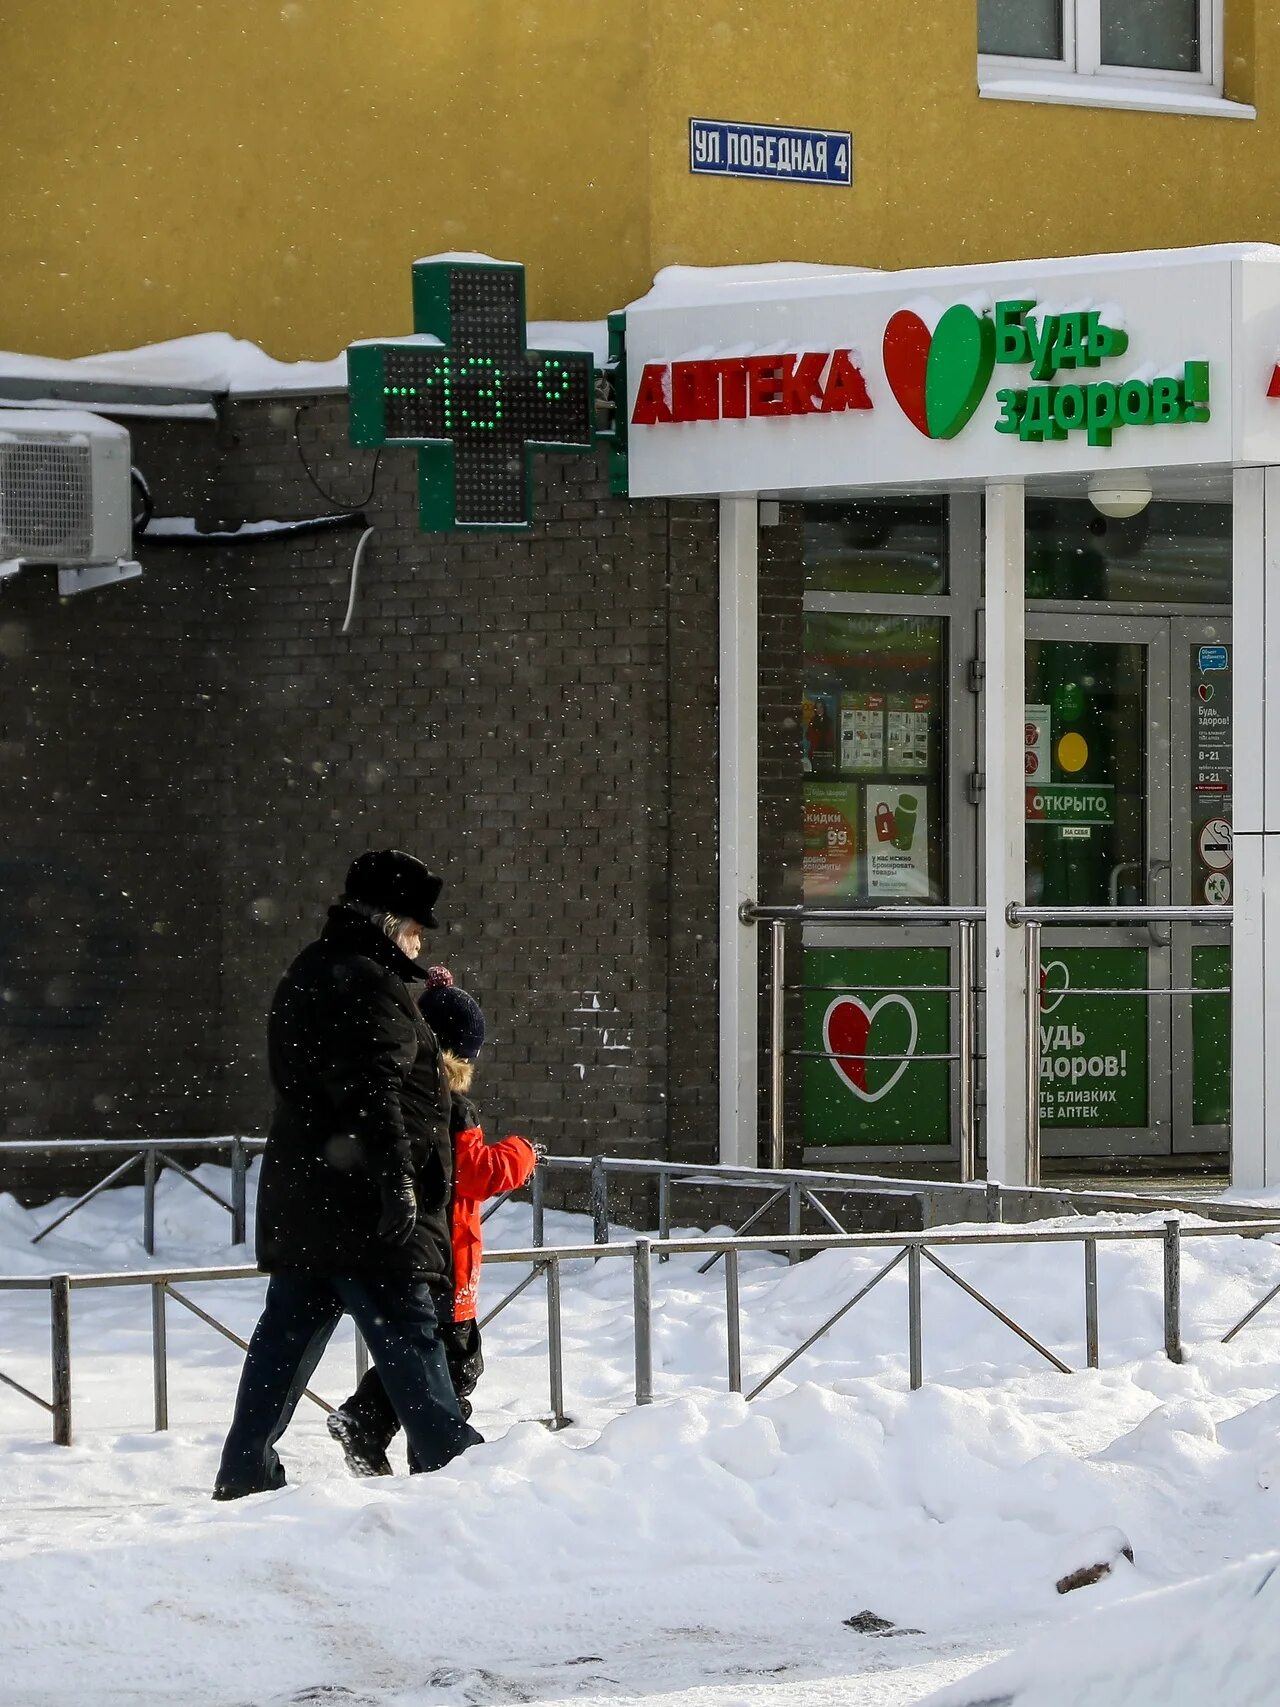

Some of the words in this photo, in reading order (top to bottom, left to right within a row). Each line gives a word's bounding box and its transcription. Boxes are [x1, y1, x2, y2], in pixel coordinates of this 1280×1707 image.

[695, 130, 725, 163] УЛ.
[727, 132, 827, 173] ПОБЕДНАЯ
[834, 143, 847, 174] 4
[995, 300, 1129, 381] Будь
[631, 349, 874, 424] АПТЕКА
[994, 361, 1210, 446] здоров!
[1198, 706, 1218, 717] Будь
[1198, 716, 1230, 727] здоров!
[1033, 795, 1107, 812] ОТКРЫТО
[1057, 1090, 1117, 1102] БЛИЗКИХ
[1057, 1106, 1100, 1118] АПТЕК
